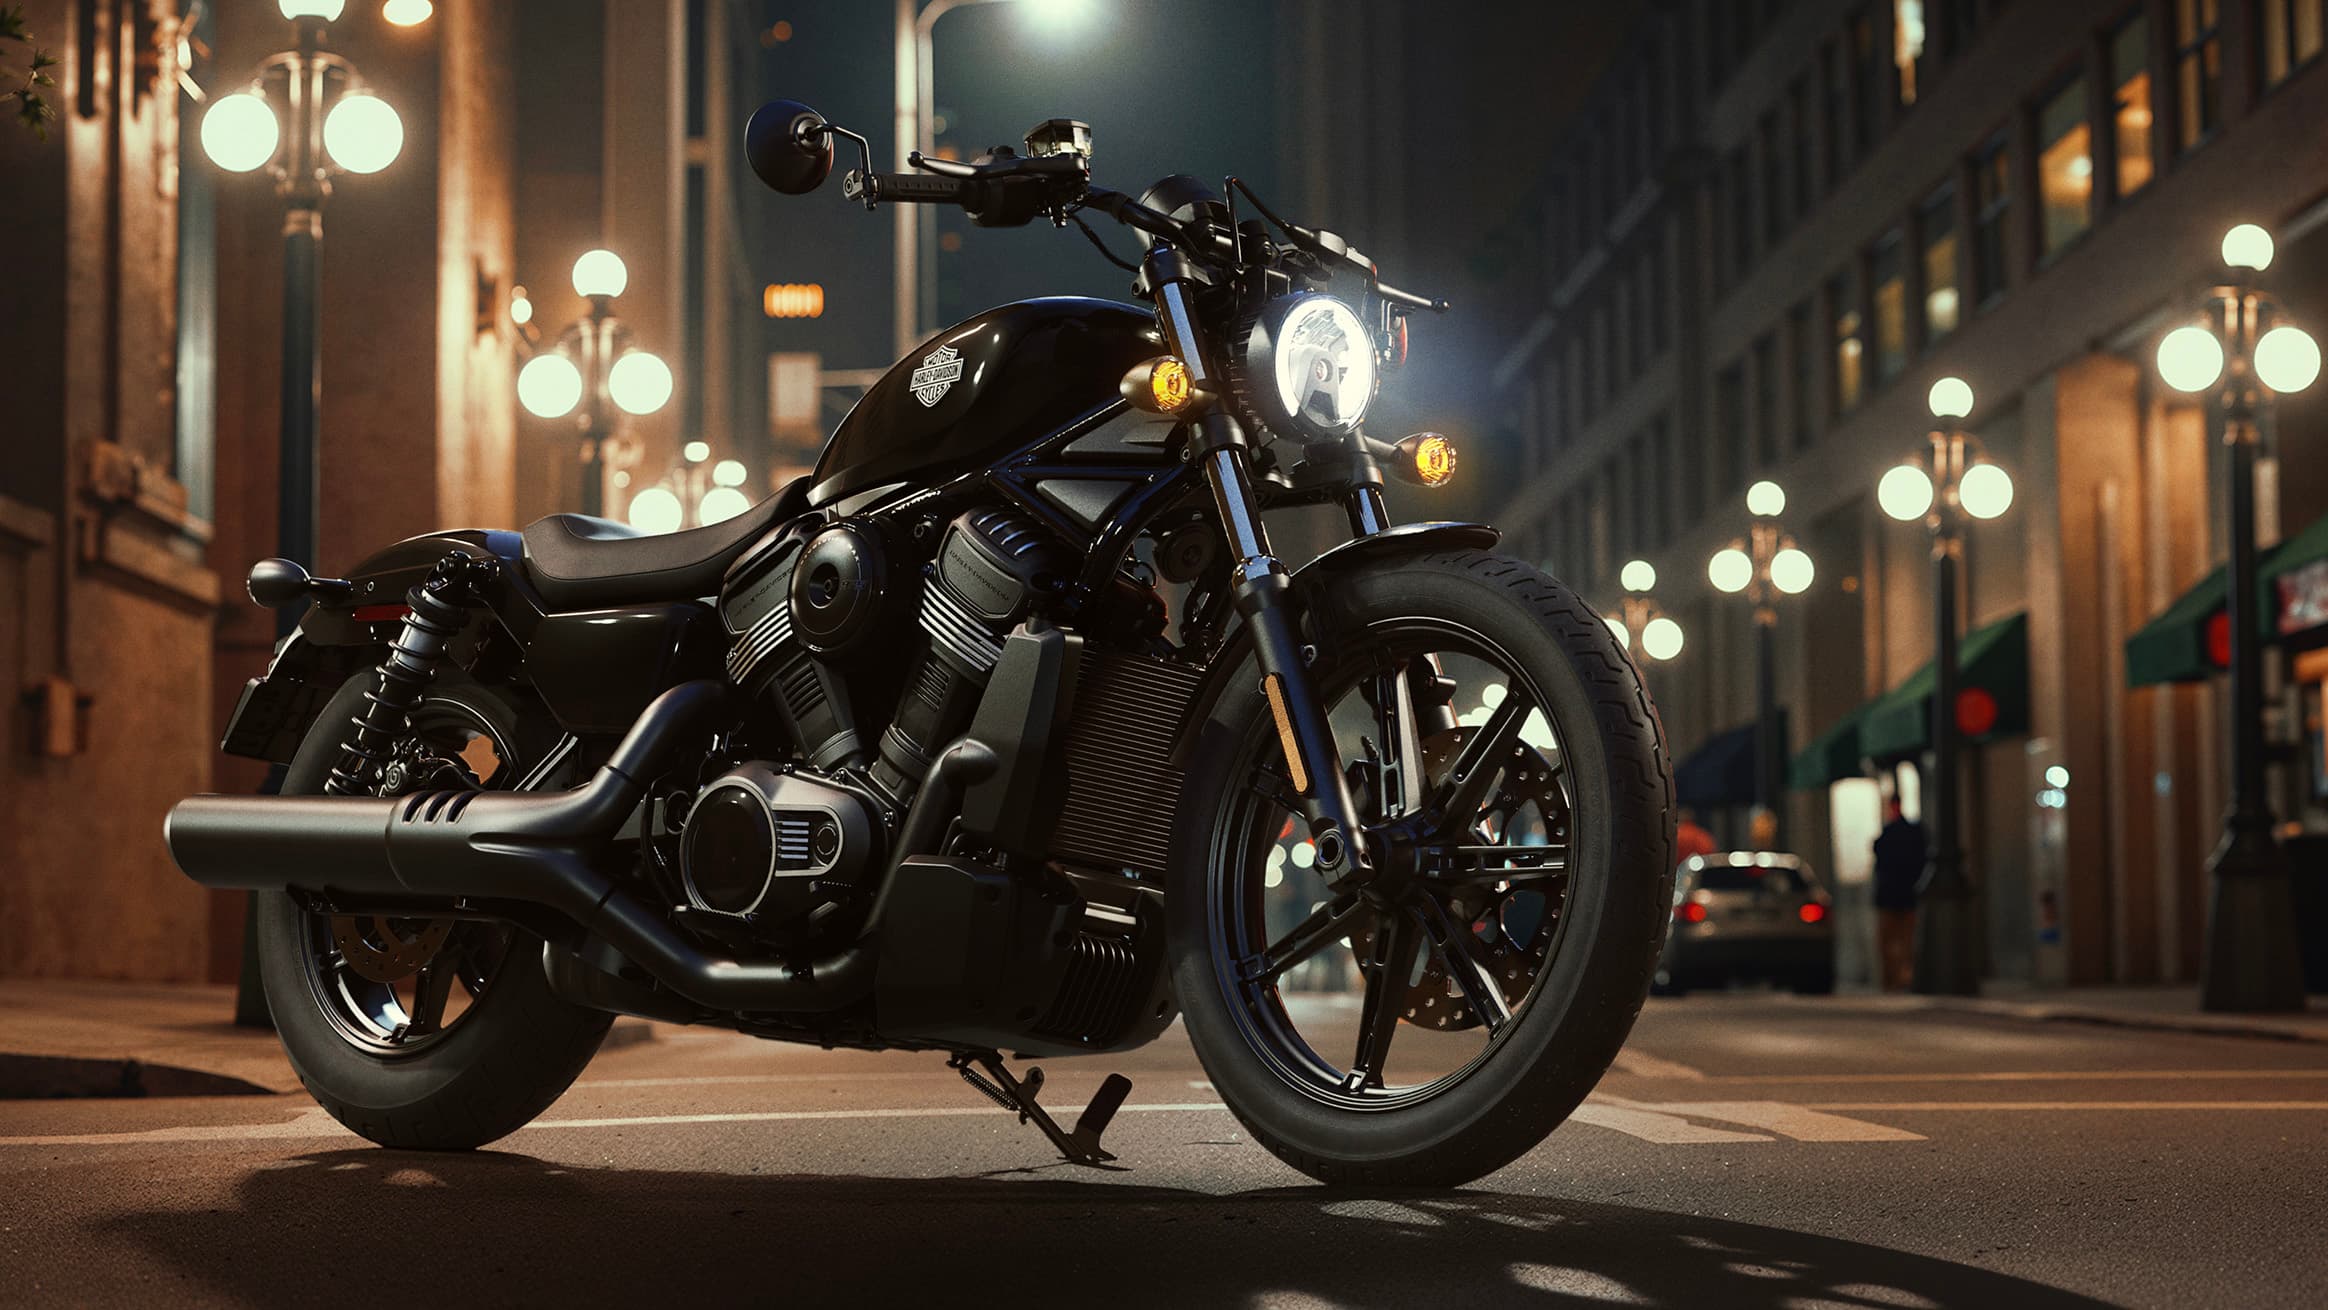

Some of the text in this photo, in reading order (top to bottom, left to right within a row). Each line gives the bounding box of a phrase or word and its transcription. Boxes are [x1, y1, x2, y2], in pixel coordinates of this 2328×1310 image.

[928, 351, 952, 365] MOTOR
[914, 363, 959, 386] HARLEY-DAVIDSON
[921, 382, 946, 401] CYCLES
